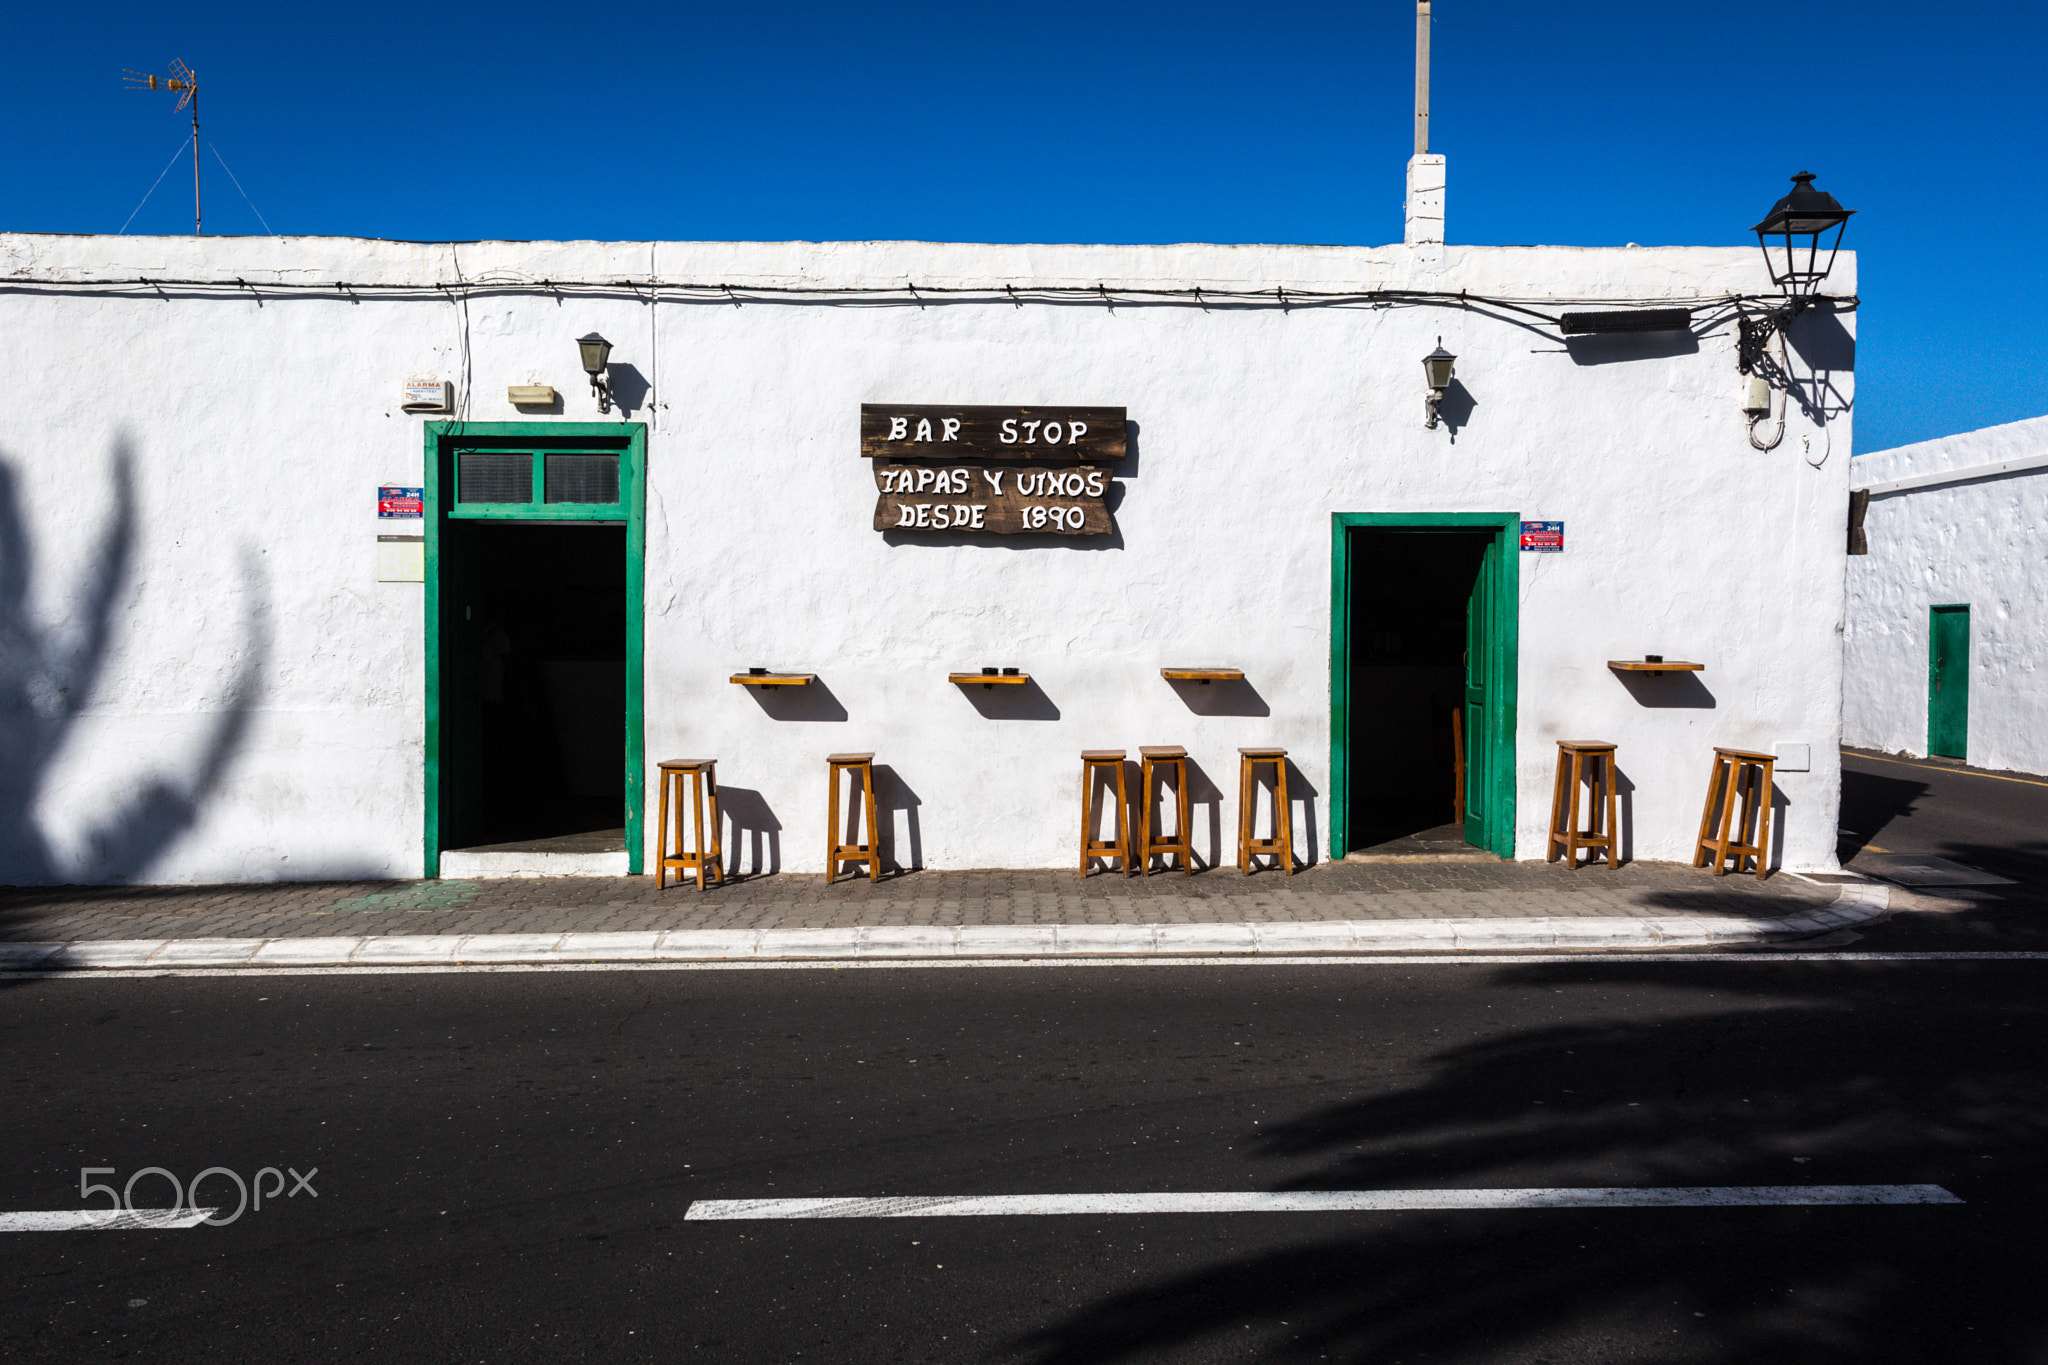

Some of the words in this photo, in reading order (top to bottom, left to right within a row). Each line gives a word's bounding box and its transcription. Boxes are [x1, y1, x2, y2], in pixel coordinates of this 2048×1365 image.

[887, 416, 961, 443] BAR
[999, 418, 1088, 445] STOP
[880, 468, 970, 494] TAPAS
[983, 470, 1004, 495] Y
[895, 503, 987, 529] DESDE
[1020, 505, 1085, 532] 1890
